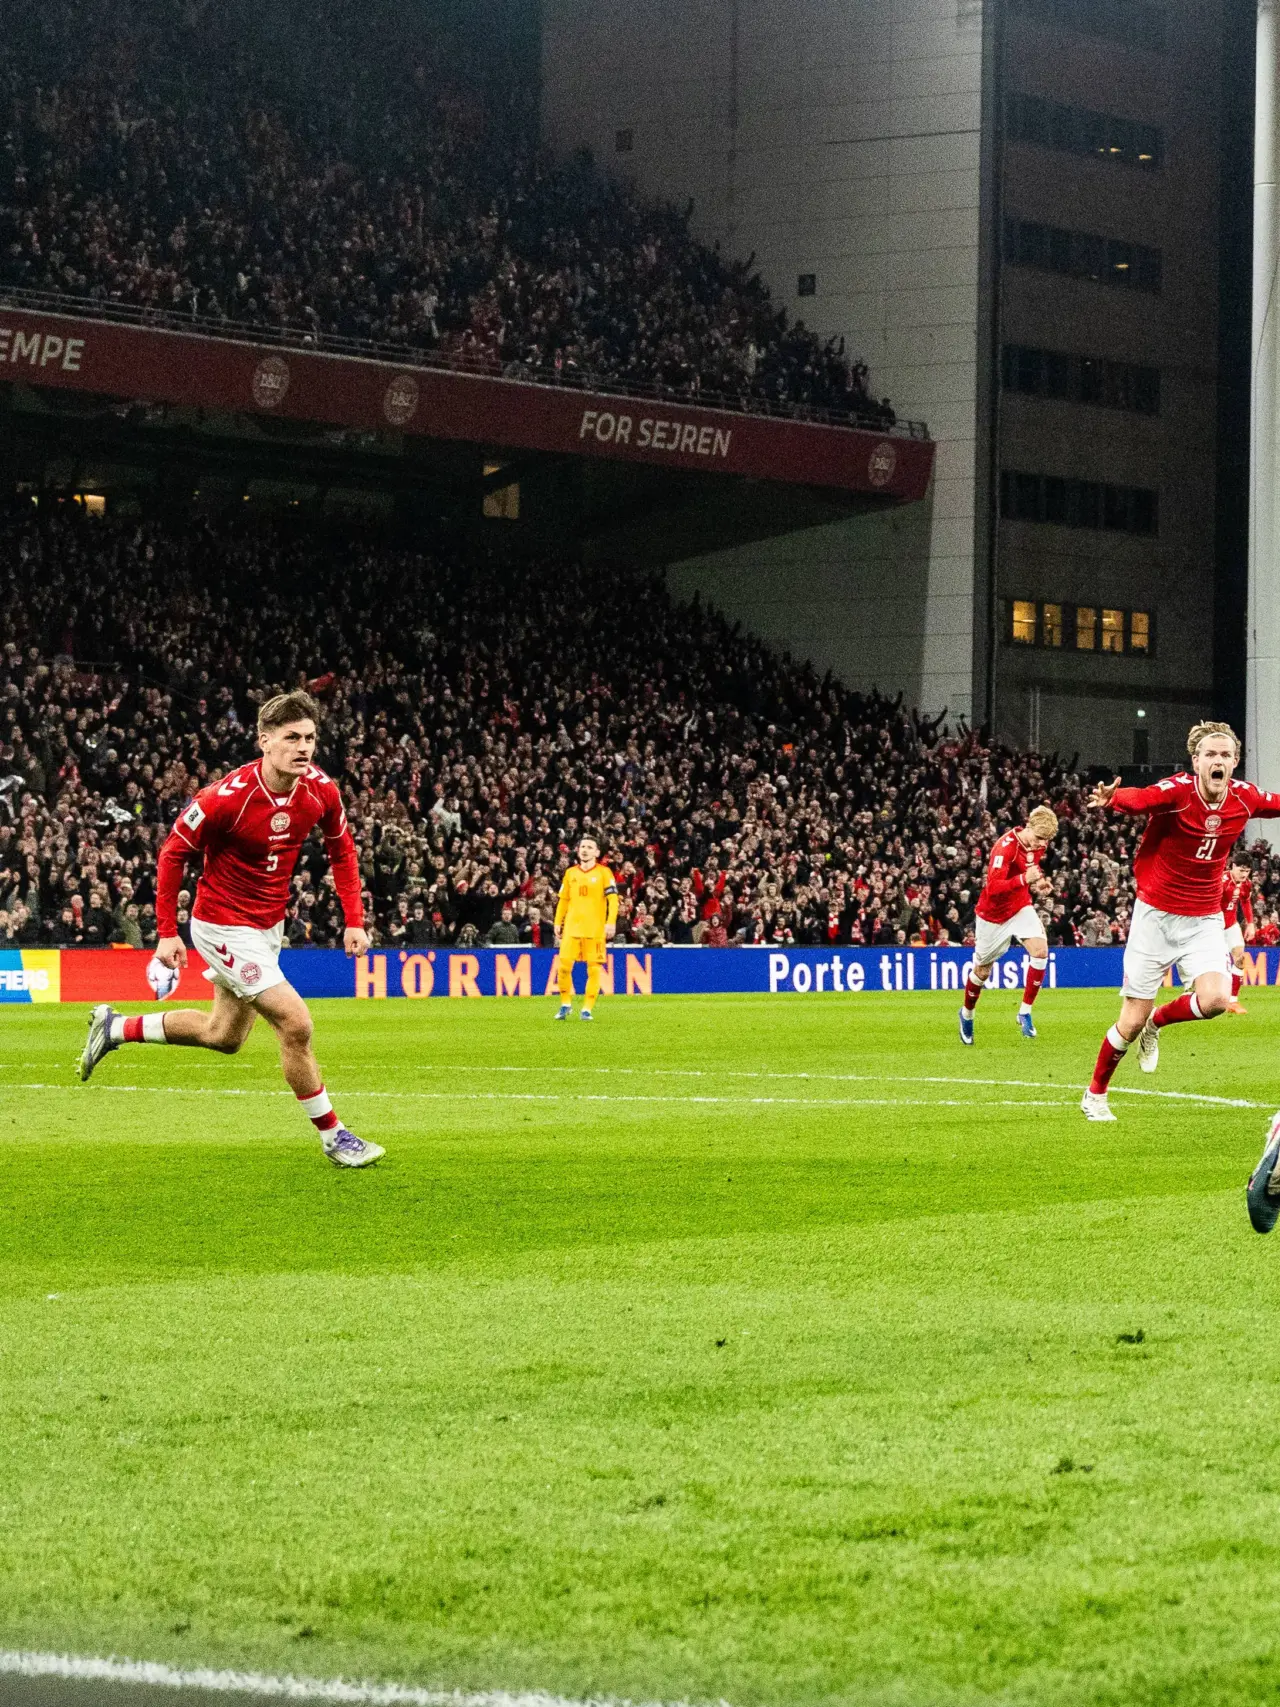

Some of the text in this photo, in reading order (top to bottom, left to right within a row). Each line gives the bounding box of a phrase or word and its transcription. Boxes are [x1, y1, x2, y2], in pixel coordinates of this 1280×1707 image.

[579, 411, 732, 458] FOR SEJREN
[1196, 838, 1218, 860] 21
[578, 885, 589, 897] 10
[769, 952, 1057, 992] Porte til industi
